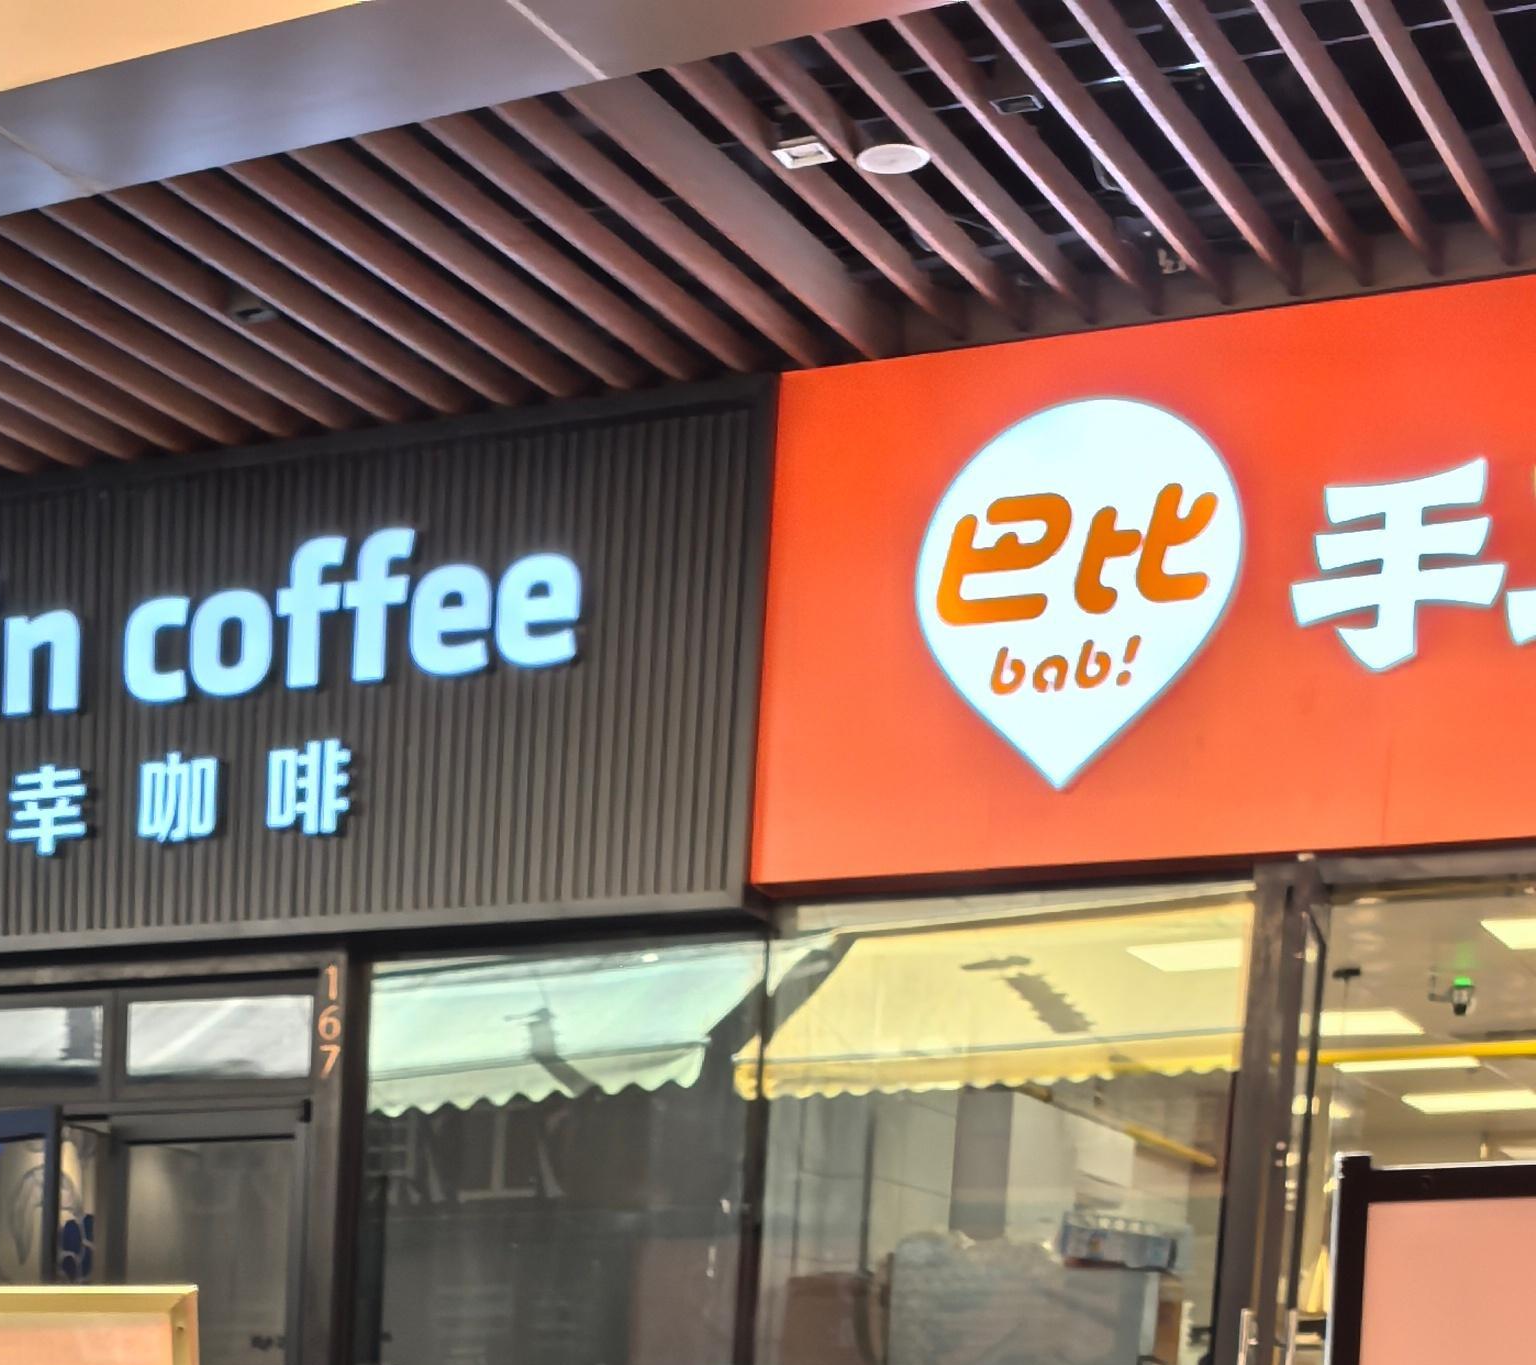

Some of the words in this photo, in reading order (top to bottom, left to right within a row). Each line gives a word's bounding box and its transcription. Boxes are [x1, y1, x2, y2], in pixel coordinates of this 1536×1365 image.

[125, 527, 581, 704] coffee
[936, 482, 1218, 626] 巴比
[1291, 455, 1536, 671] 手
[317, 963, 342, 1079] 167
